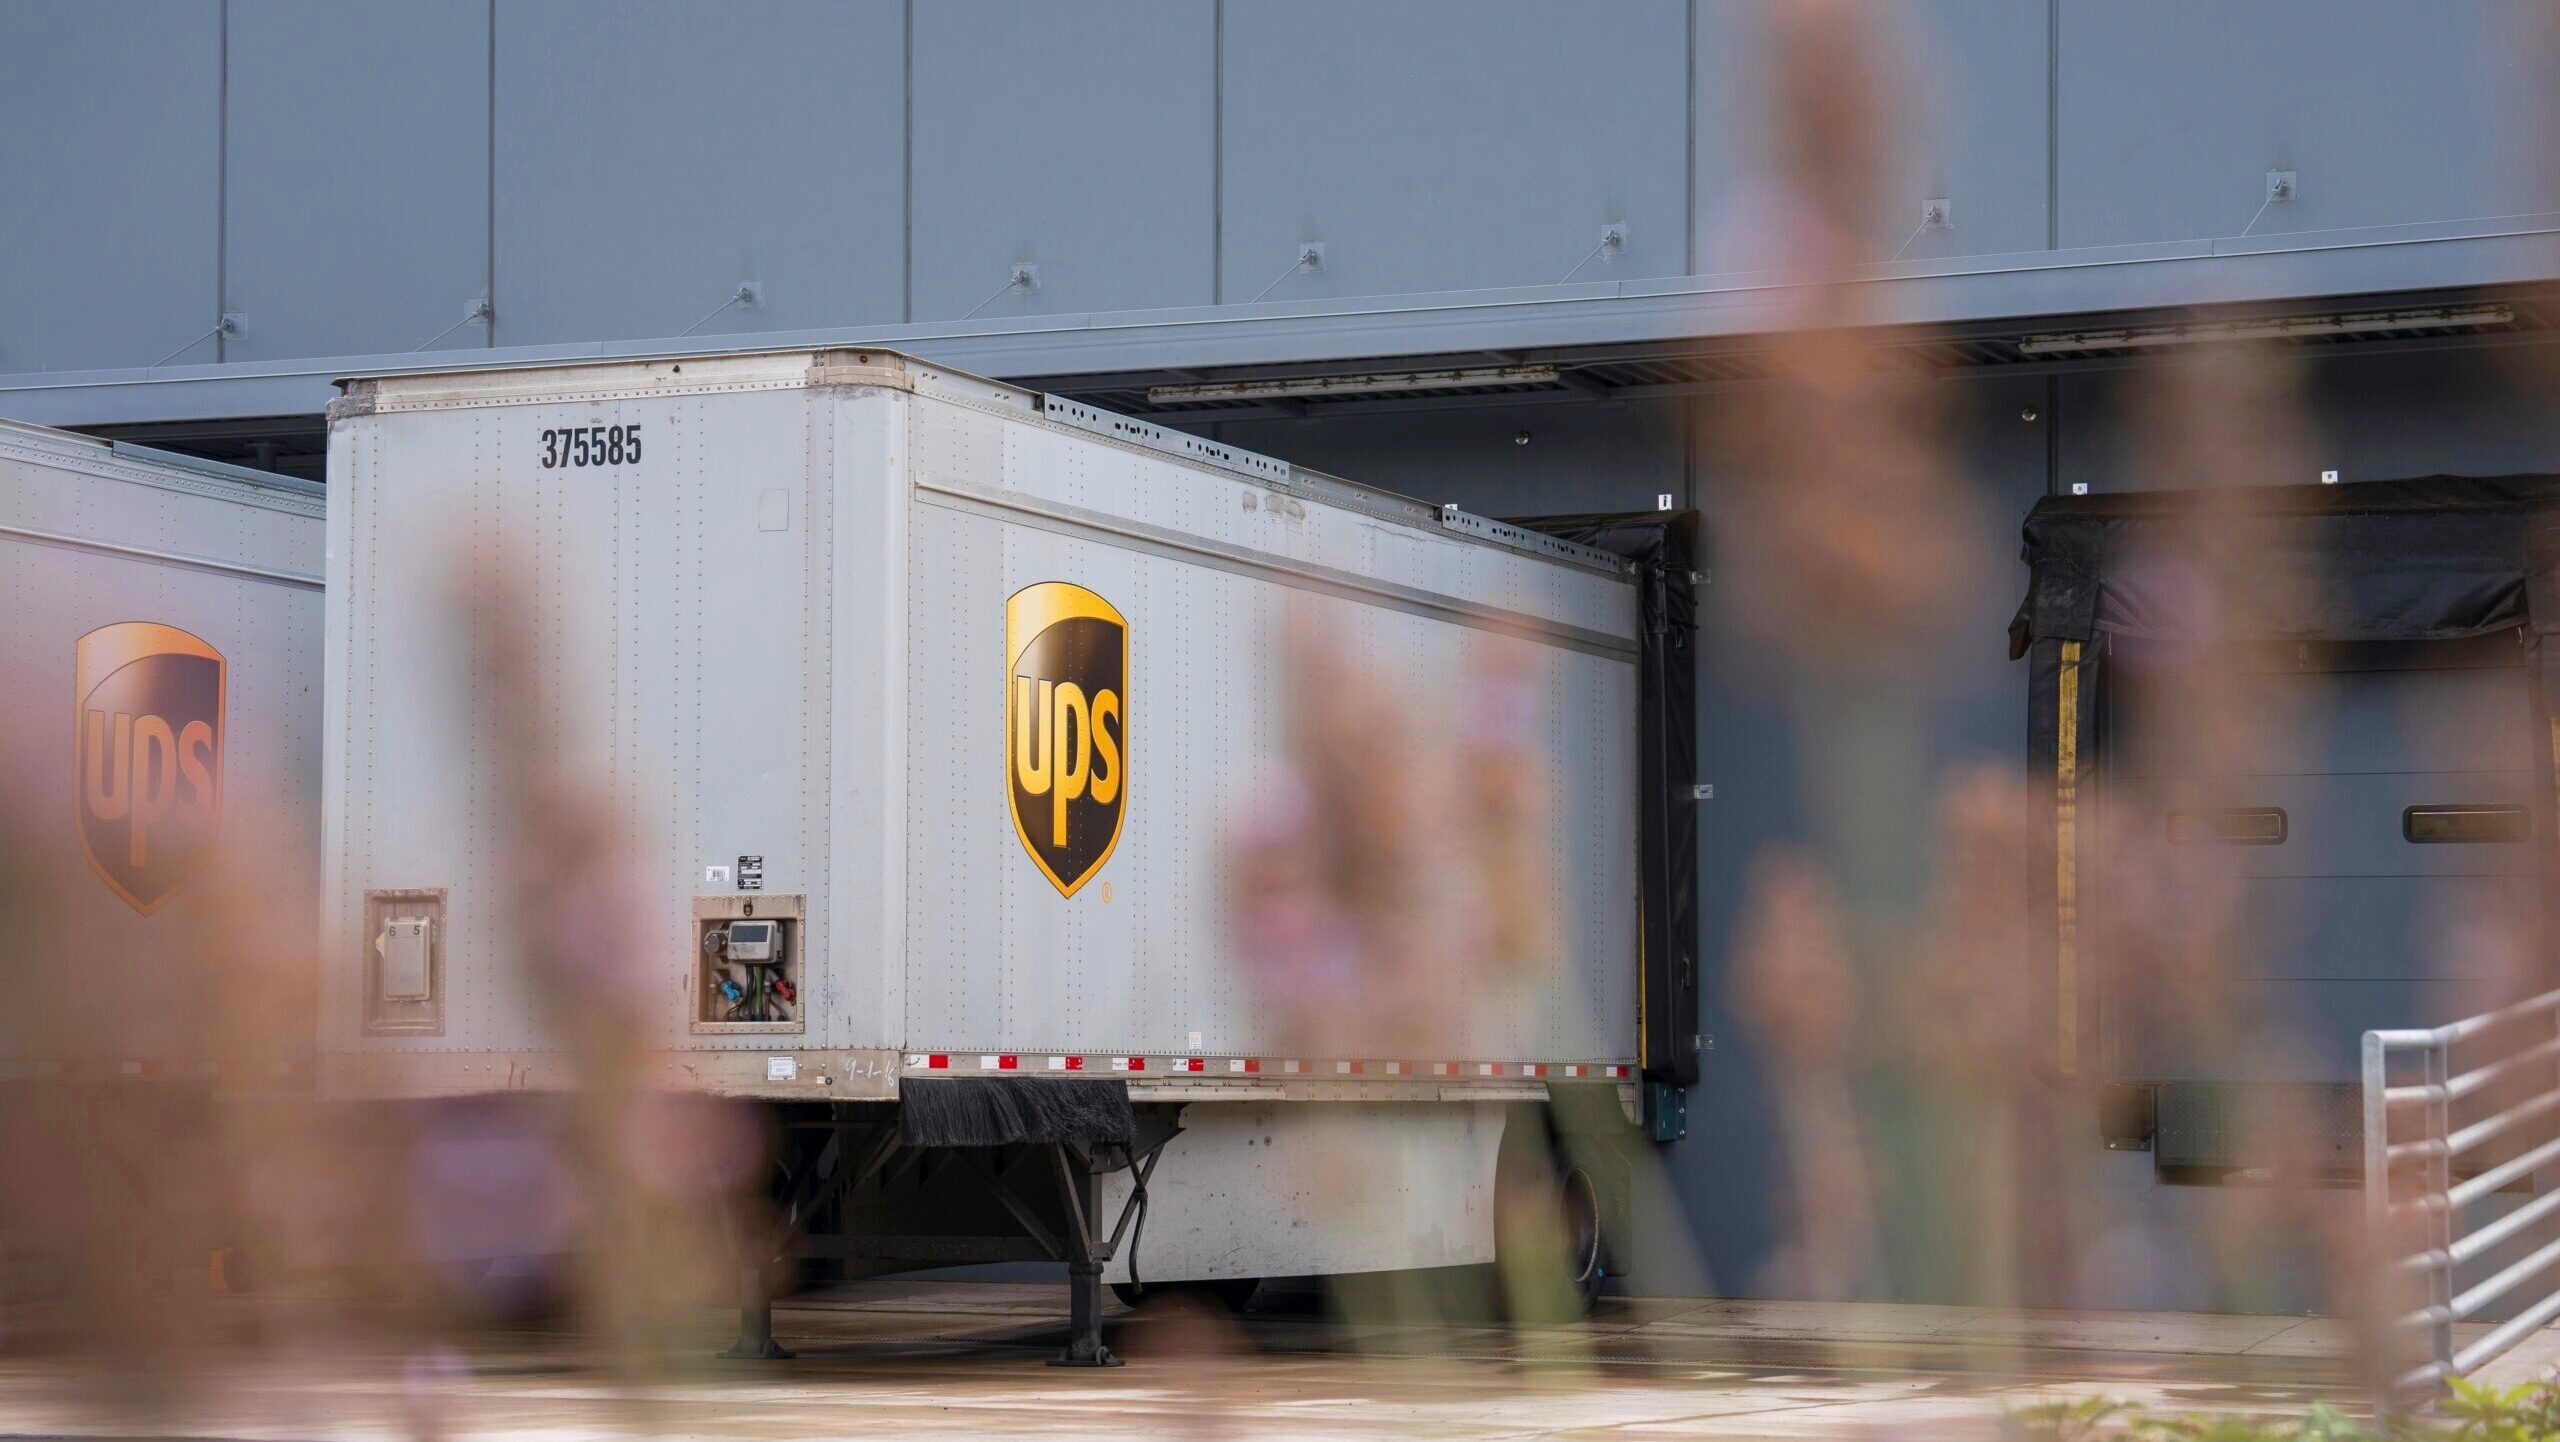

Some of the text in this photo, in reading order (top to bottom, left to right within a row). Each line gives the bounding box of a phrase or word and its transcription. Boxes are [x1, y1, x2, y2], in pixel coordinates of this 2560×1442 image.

[541, 424, 642, 469] 375585
[87, 710, 213, 868] ups
[1016, 675, 1120, 848] ups
[388, 926, 397, 937] 6
